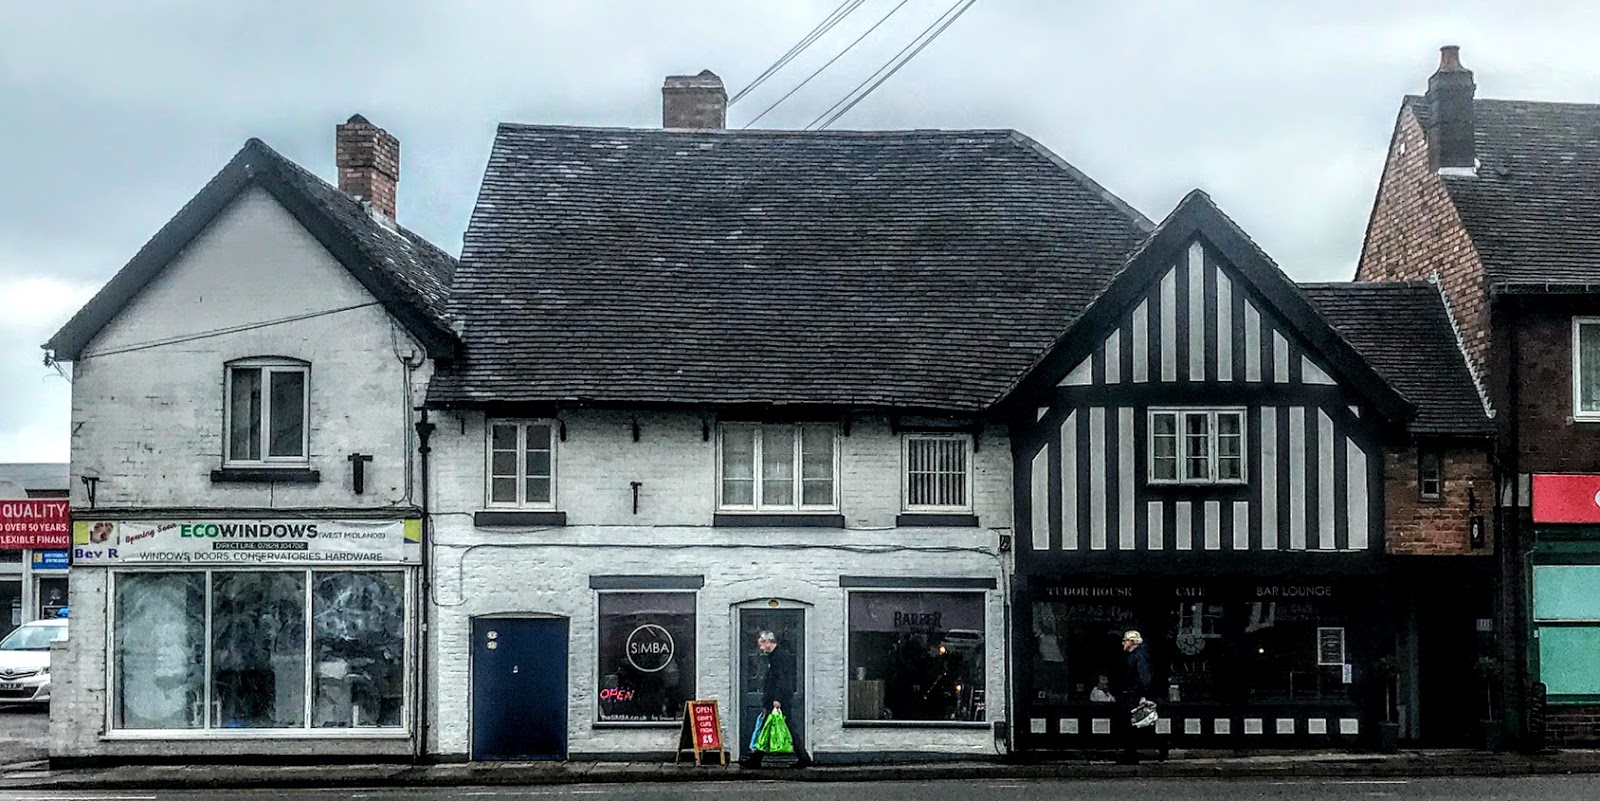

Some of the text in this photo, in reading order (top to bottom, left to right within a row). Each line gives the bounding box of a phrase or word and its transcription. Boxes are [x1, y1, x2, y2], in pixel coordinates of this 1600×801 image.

[2, 503, 67, 518] QUALITY
[4, 523, 27, 532] OVER
[28, 523, 39, 532] 50
[39, 523, 69, 532] YEARS.
[180, 523, 318, 538] ECOWINDOWS
[125, 530, 155, 544] Opening
[74, 548, 103, 559] Bev
[107, 548, 119, 559] R
[325, 552, 383, 561] HARDWARE
[1047, 586, 1132, 597] TUDOR HOUSE
[1256, 586, 1332, 597] BAR LOUNGE
[894, 611, 943, 628] BARBER
[631, 642, 670, 654] SIMBA
[600, 688, 634, 701] OPEN
[695, 706, 713, 714] OPEN
[702, 735, 714, 744] £5
